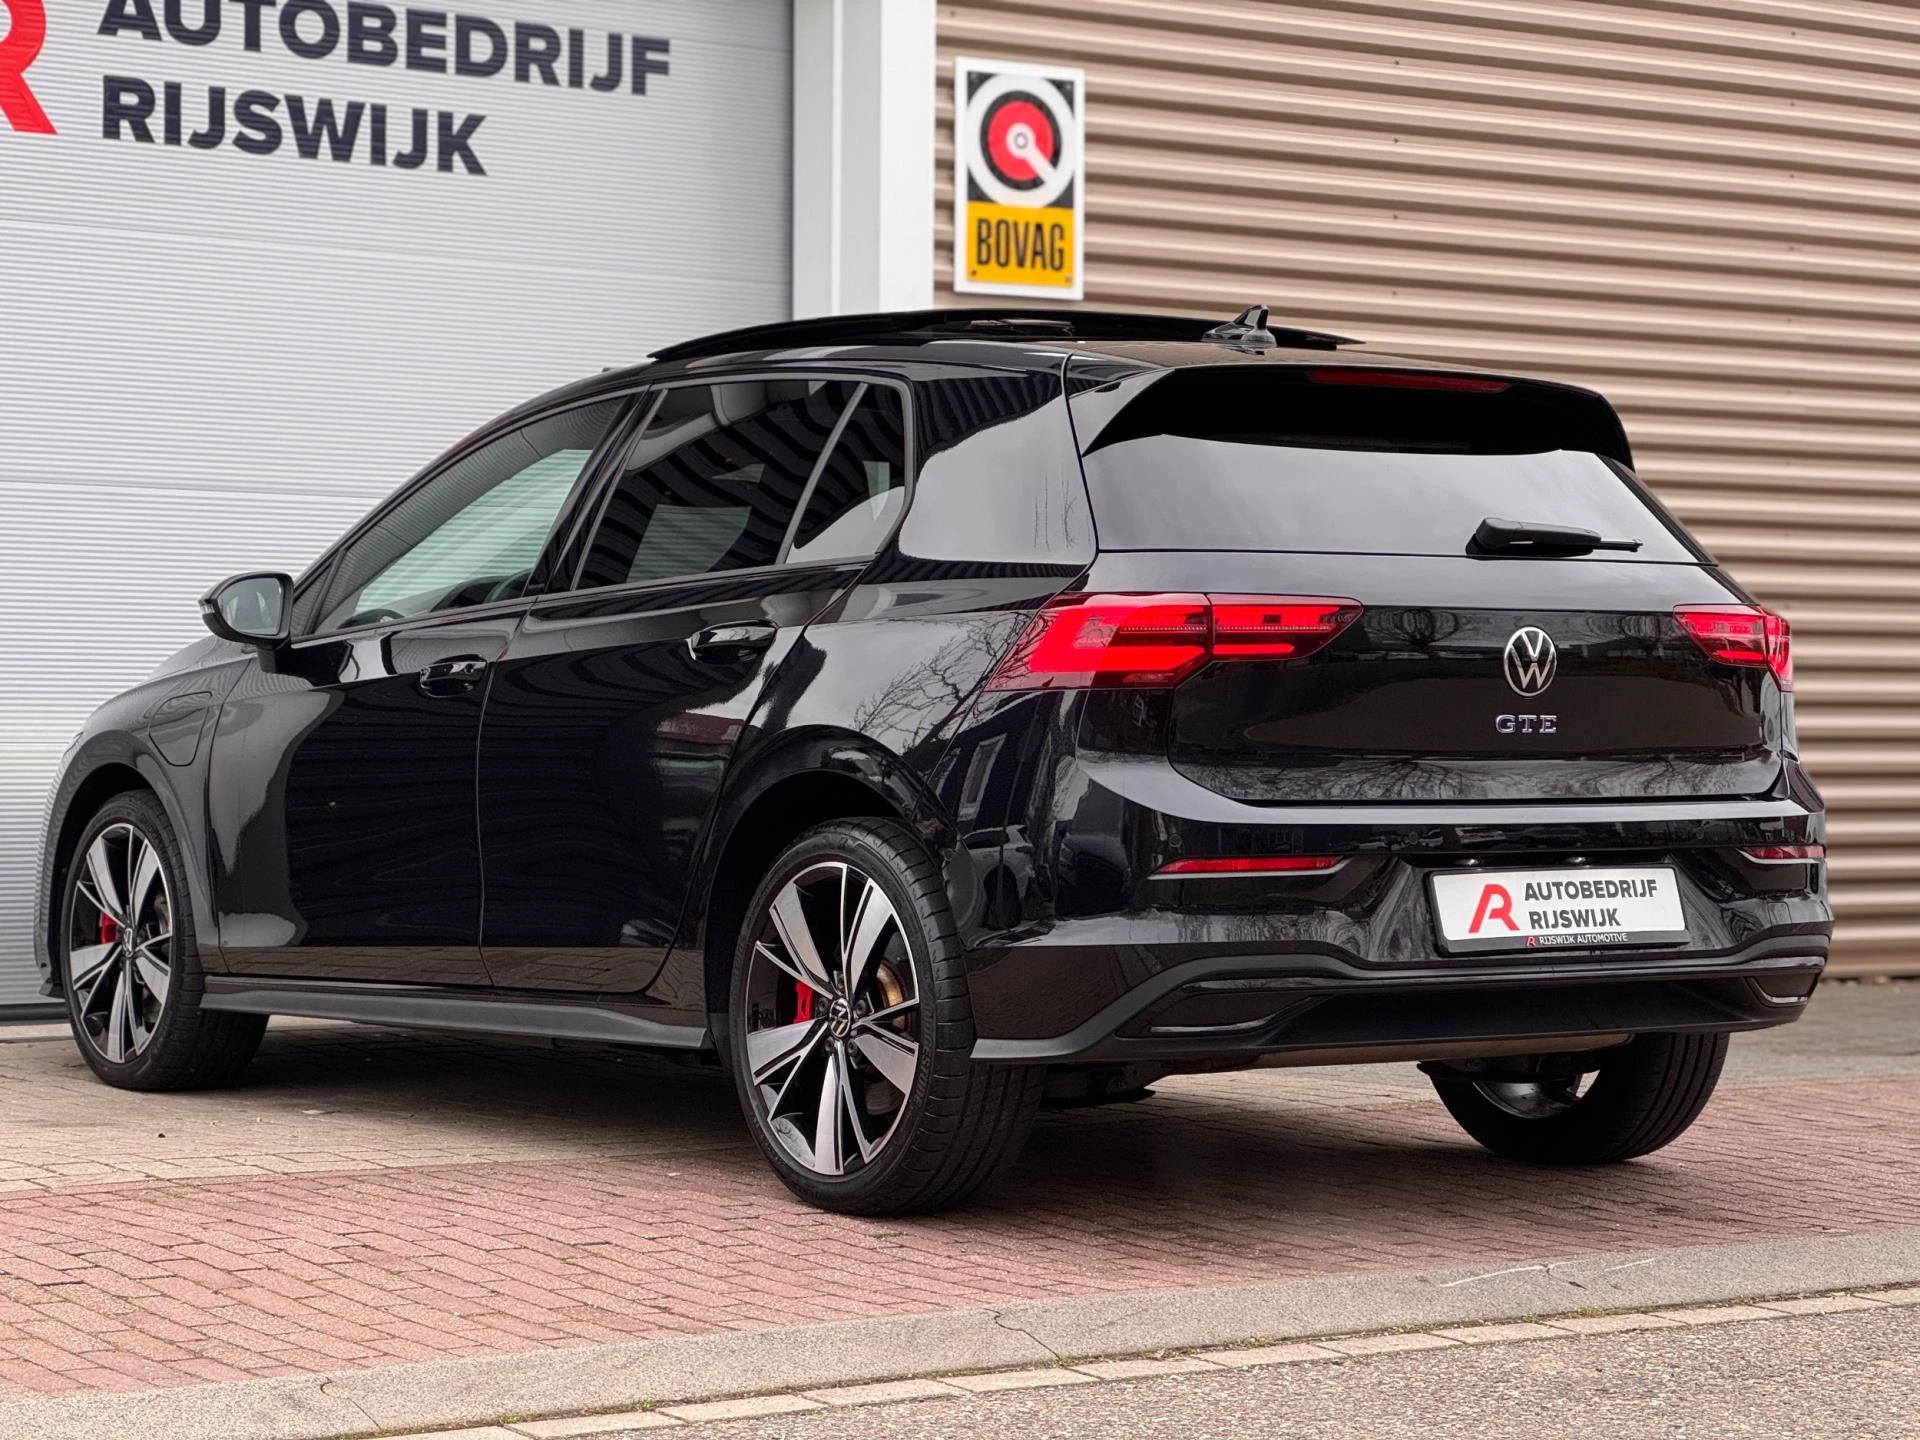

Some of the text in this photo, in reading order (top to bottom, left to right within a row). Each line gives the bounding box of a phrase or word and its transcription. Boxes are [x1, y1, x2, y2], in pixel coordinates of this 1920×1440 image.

[97, 0, 670, 96] AUTOBEDRIJF
[102, 74, 488, 176] RIJSWIJK
[976, 218, 1065, 272] BOVAG
[1495, 714, 1557, 734] GTE
[1524, 879, 1657, 901] AUTOBEDRIJF
[1528, 908, 1621, 930] RIJSWIJK
[1539, 932, 1628, 945] RIJSWIJK AUTOMOTIVE
